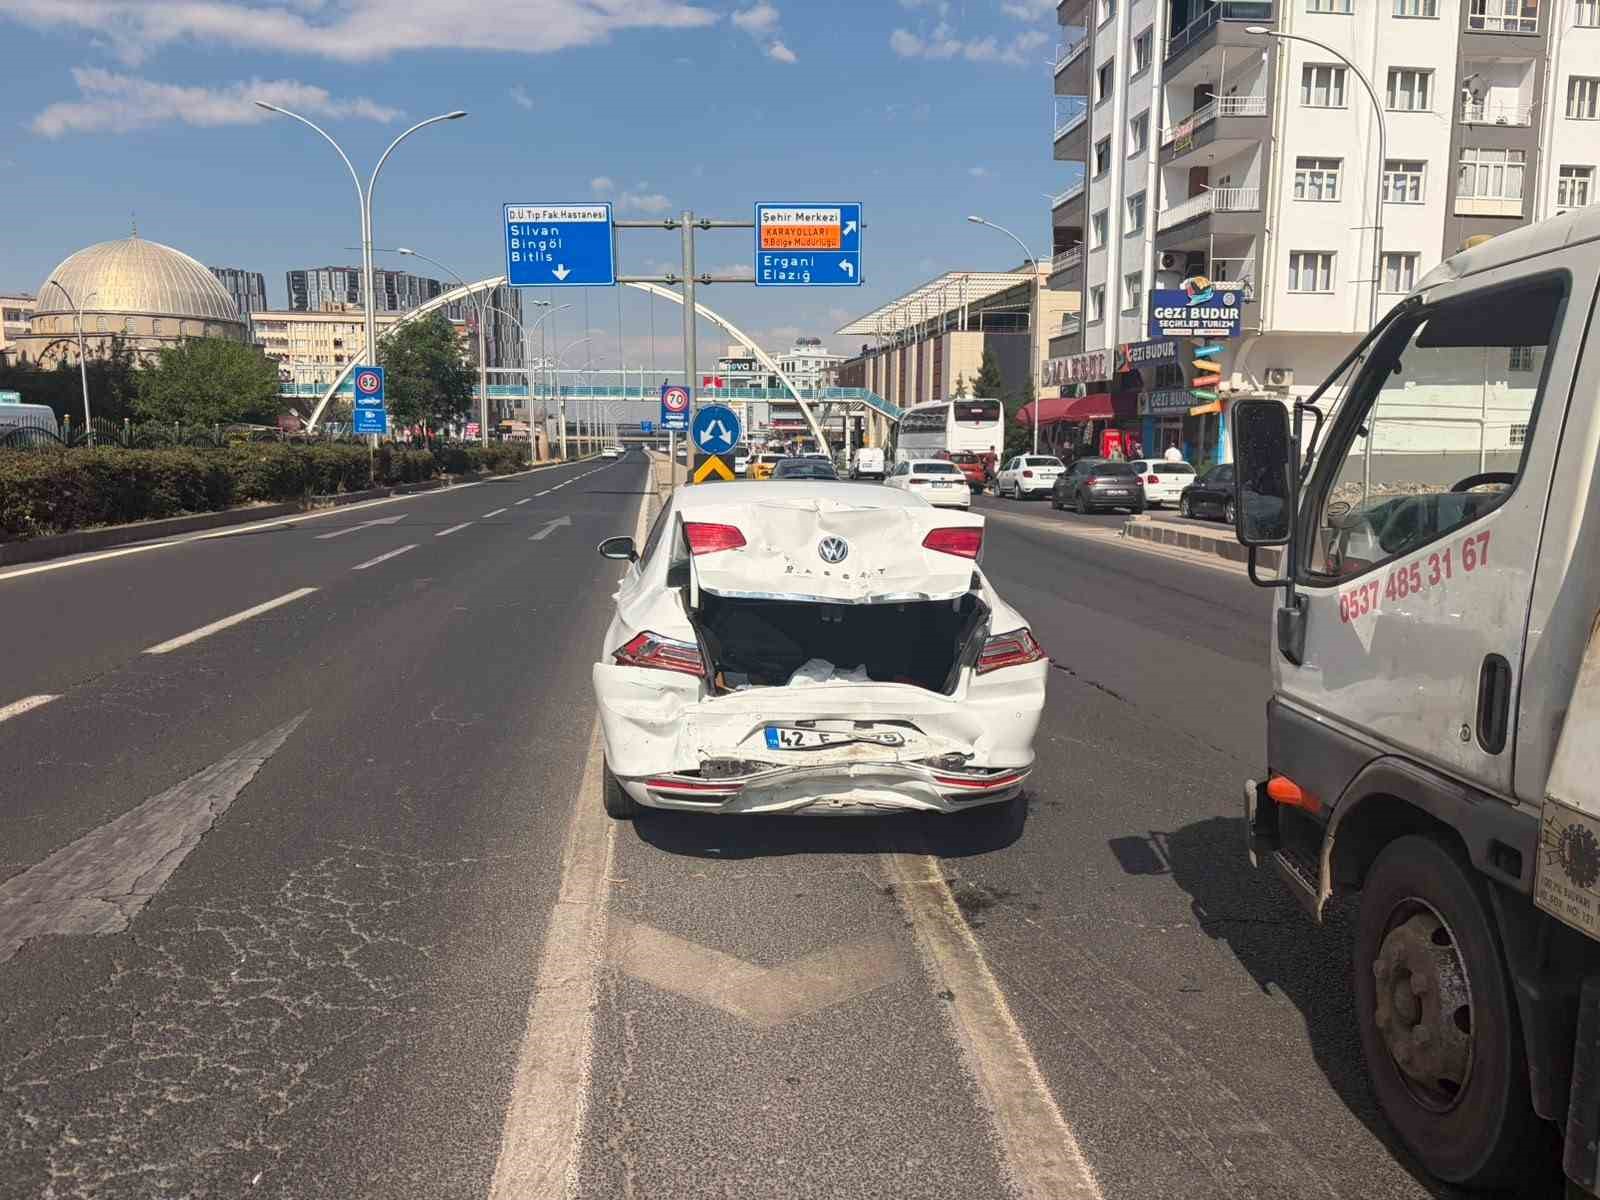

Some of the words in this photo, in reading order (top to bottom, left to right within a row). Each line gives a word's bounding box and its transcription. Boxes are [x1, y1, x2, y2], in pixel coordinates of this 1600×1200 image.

[763, 212, 792, 223] Şehir
[796, 212, 838, 222] Merkezi
[511, 225, 559, 236] Silvan
[766, 227, 829, 237] KARAYOLLARI
[511, 239, 562, 251] Bingöl
[511, 252, 553, 262] Bitlis
[764, 255, 814, 269] Ergani
[764, 270, 811, 283] Elazığ
[1190, 307, 1239, 319] BUDUR
[670, 393, 682, 405] 70
[1339, 580, 1380, 624] 0537
[1385, 561, 1422, 602] 485
[1428, 547, 1453, 586] 31
[1461, 530, 1491, 572] 67
[780, 730, 805, 747] 42
